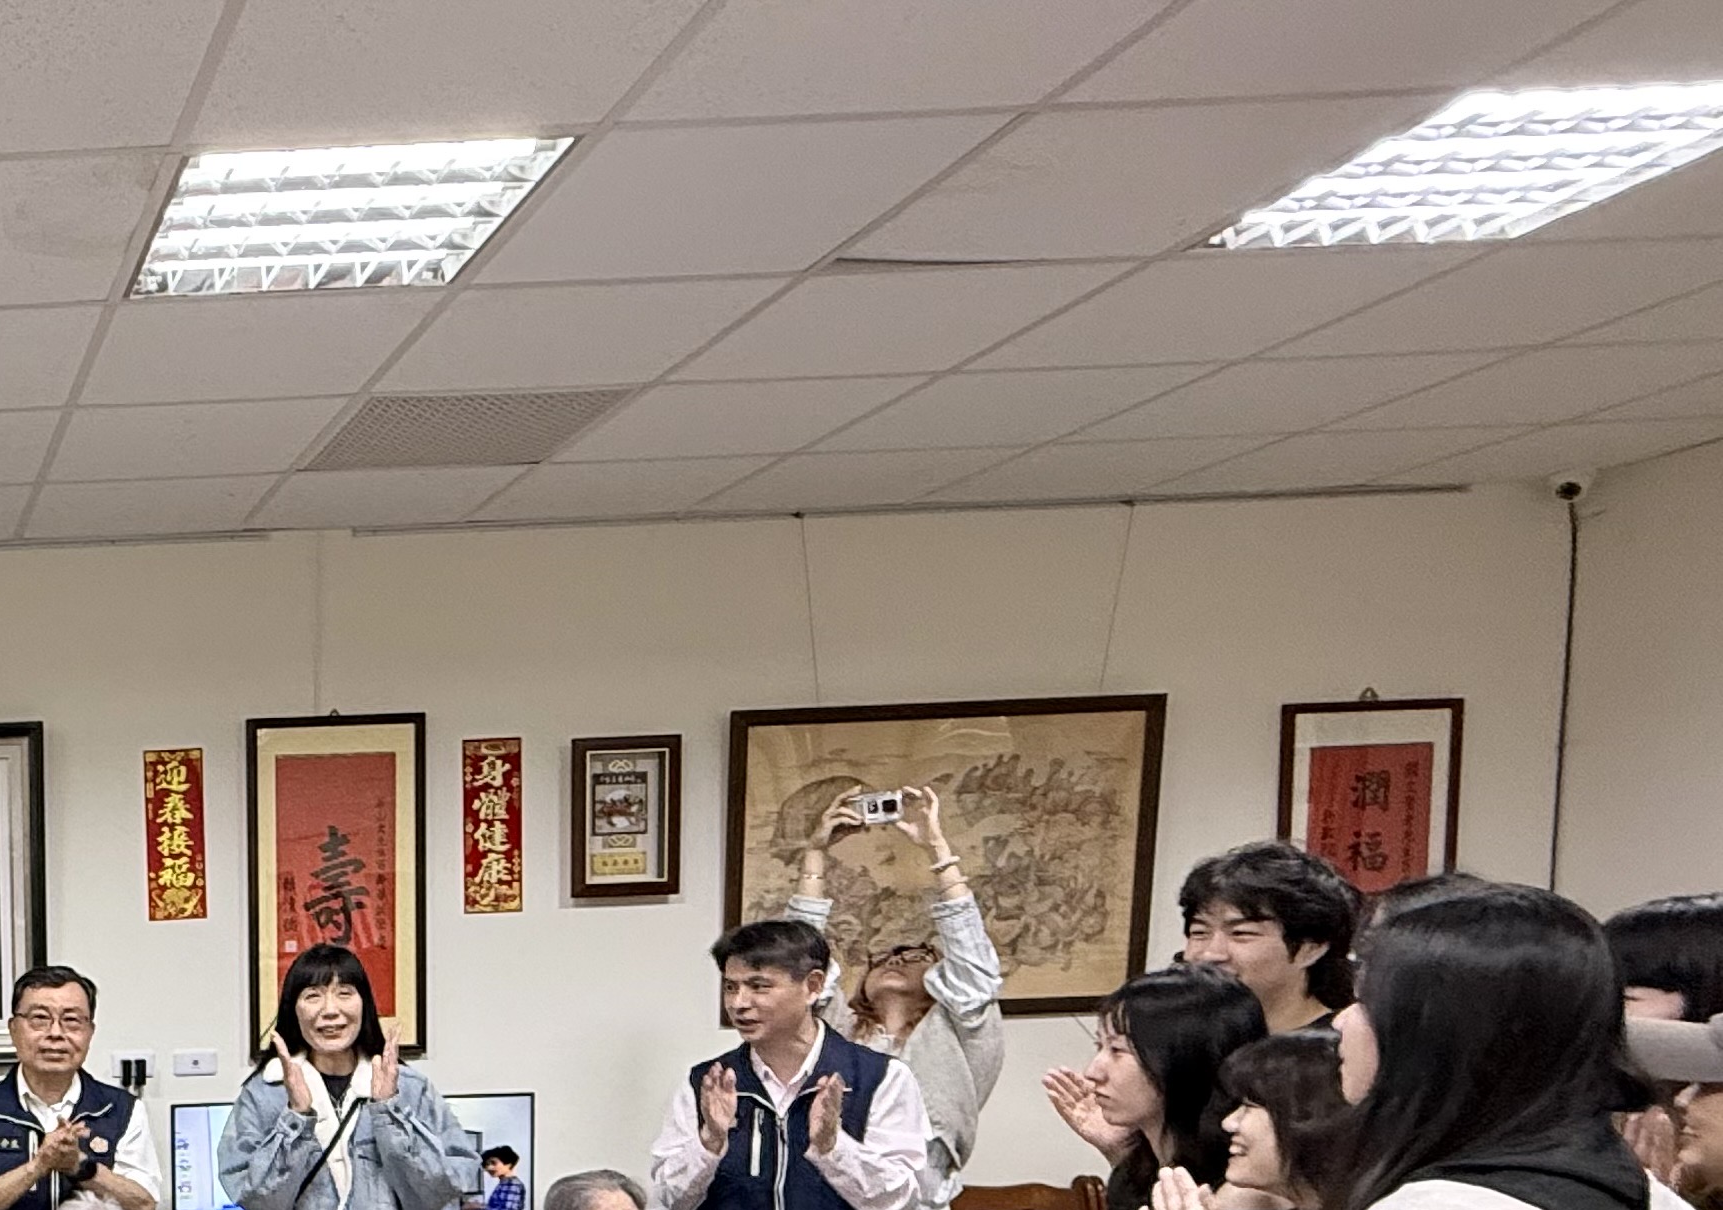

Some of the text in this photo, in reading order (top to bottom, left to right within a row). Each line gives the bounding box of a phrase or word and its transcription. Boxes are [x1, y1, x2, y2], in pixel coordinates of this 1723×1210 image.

[155, 760, 196, 888] 迎春接福
[472, 755, 513, 885] 身體健康
[303, 824, 371, 947] 壽
